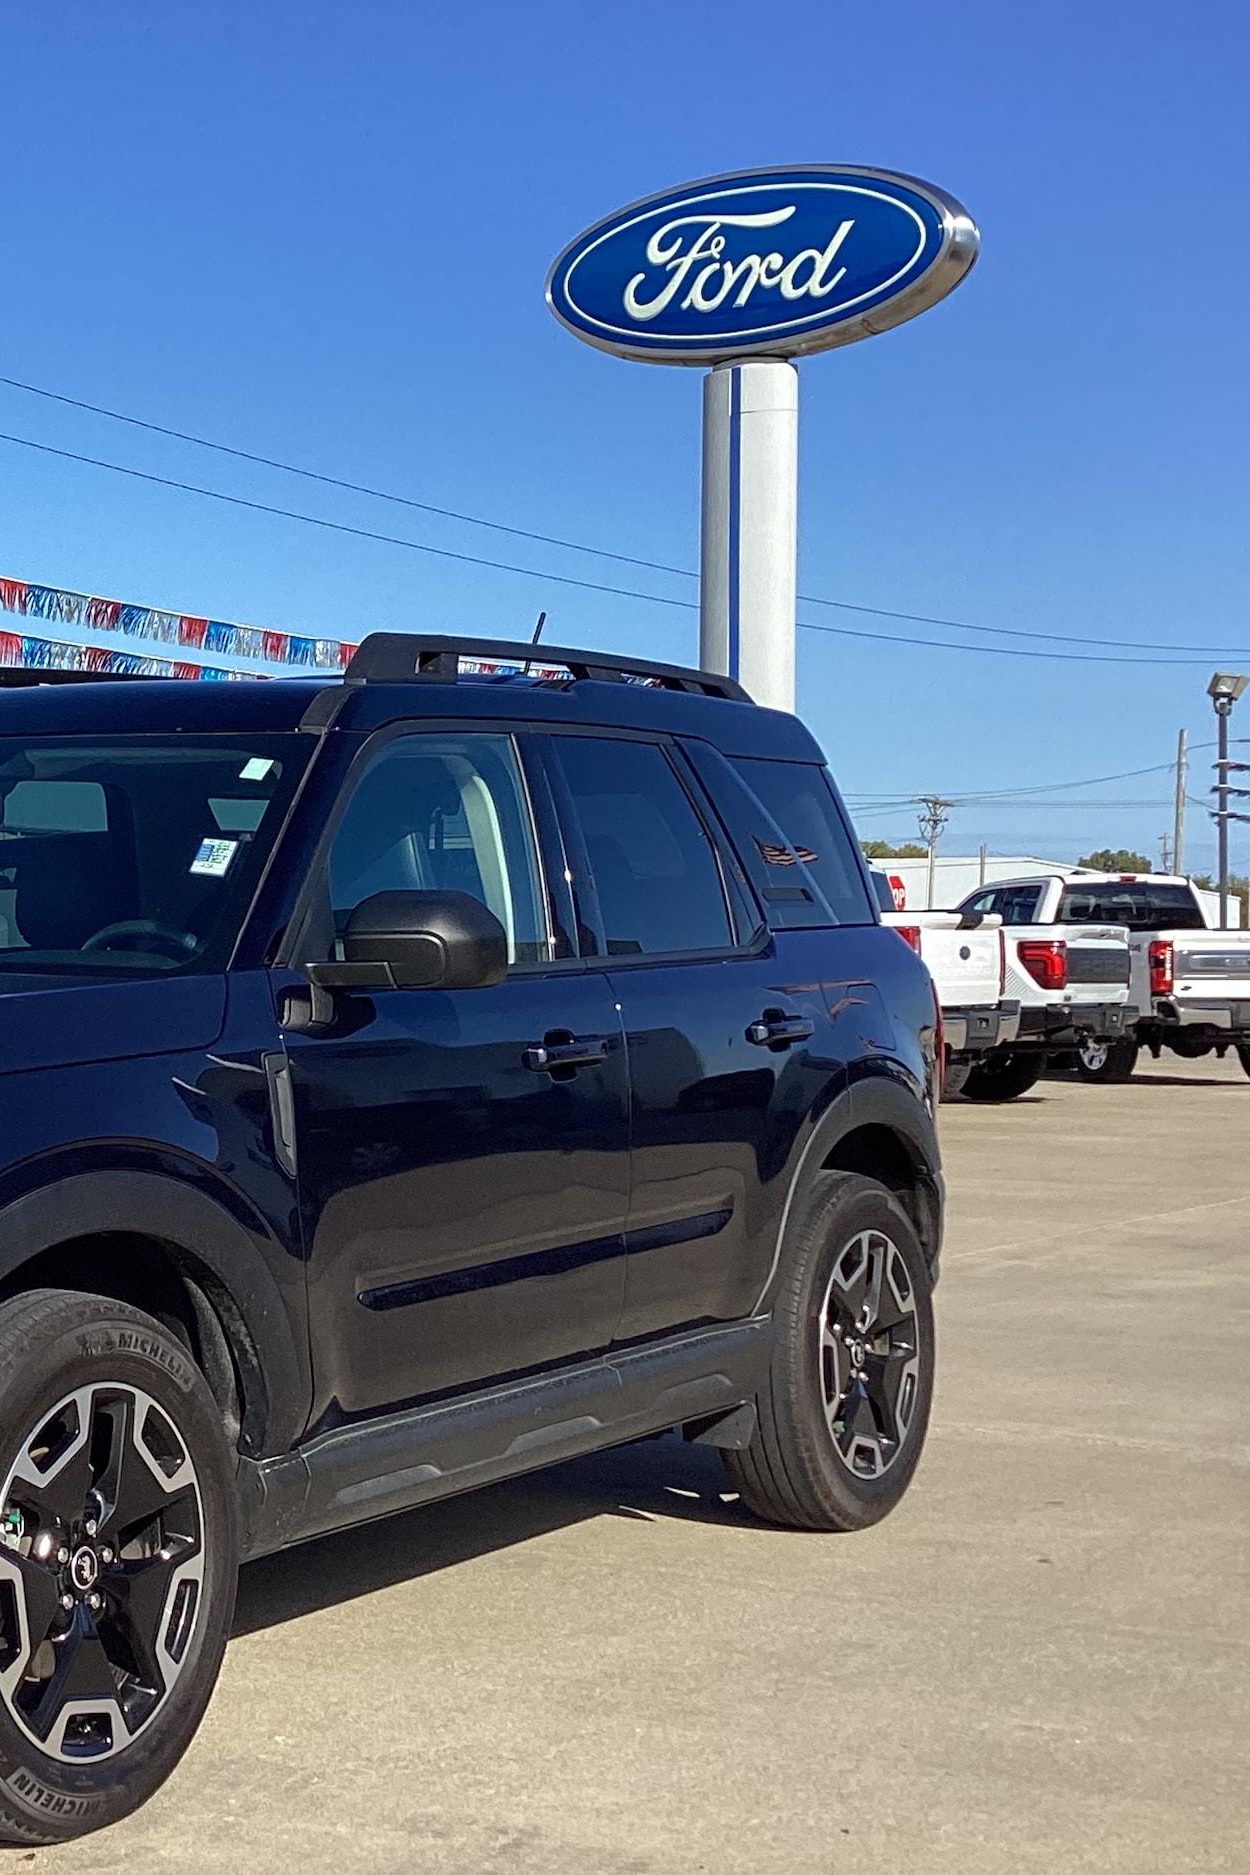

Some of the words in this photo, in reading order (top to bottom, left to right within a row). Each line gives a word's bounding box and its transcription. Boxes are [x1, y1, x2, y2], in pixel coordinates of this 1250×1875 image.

[623, 206, 855, 321] Ford
[118, 1332, 193, 1387] MICHELIN
[13, 1773, 101, 1817] MICHELIN
